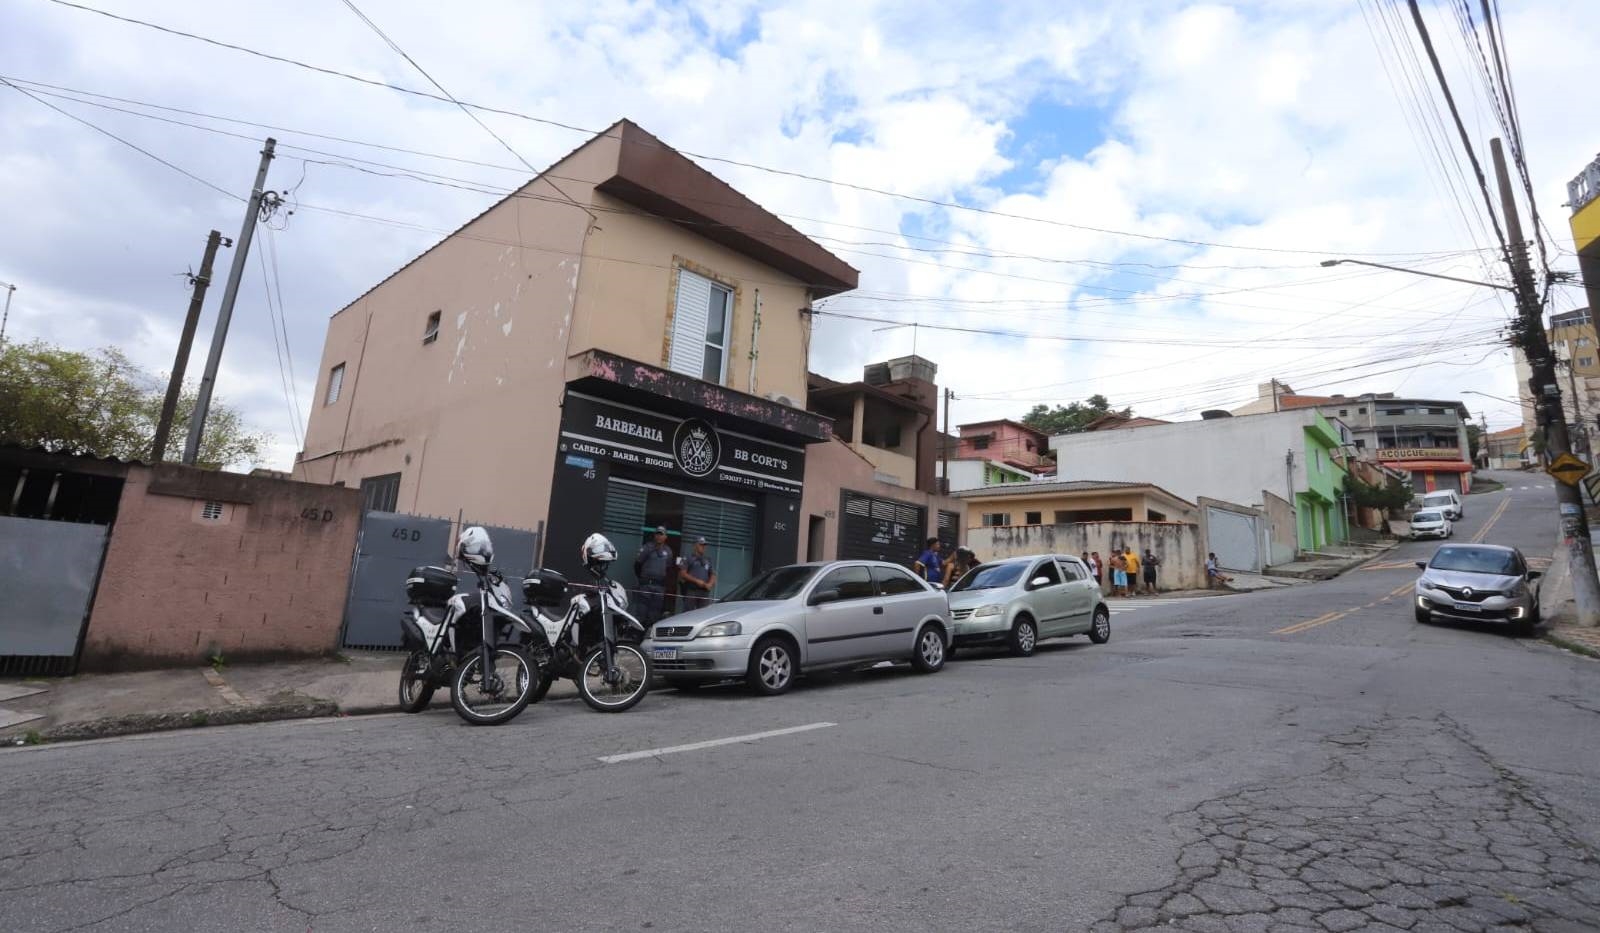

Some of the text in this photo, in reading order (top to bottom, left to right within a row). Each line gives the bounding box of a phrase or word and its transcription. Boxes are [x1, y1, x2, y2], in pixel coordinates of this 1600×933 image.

[595, 414, 664, 443] BARBEARIA
[572, 442, 606, 455] CABELO
[612, 450, 639, 463] BARBA
[645, 457, 674, 469] BIGODE
[734, 449, 788, 470] BB CORT'S
[583, 469, 596, 480] 45
[300, 508, 333, 522] 45 D
[391, 527, 421, 542] 45 D
